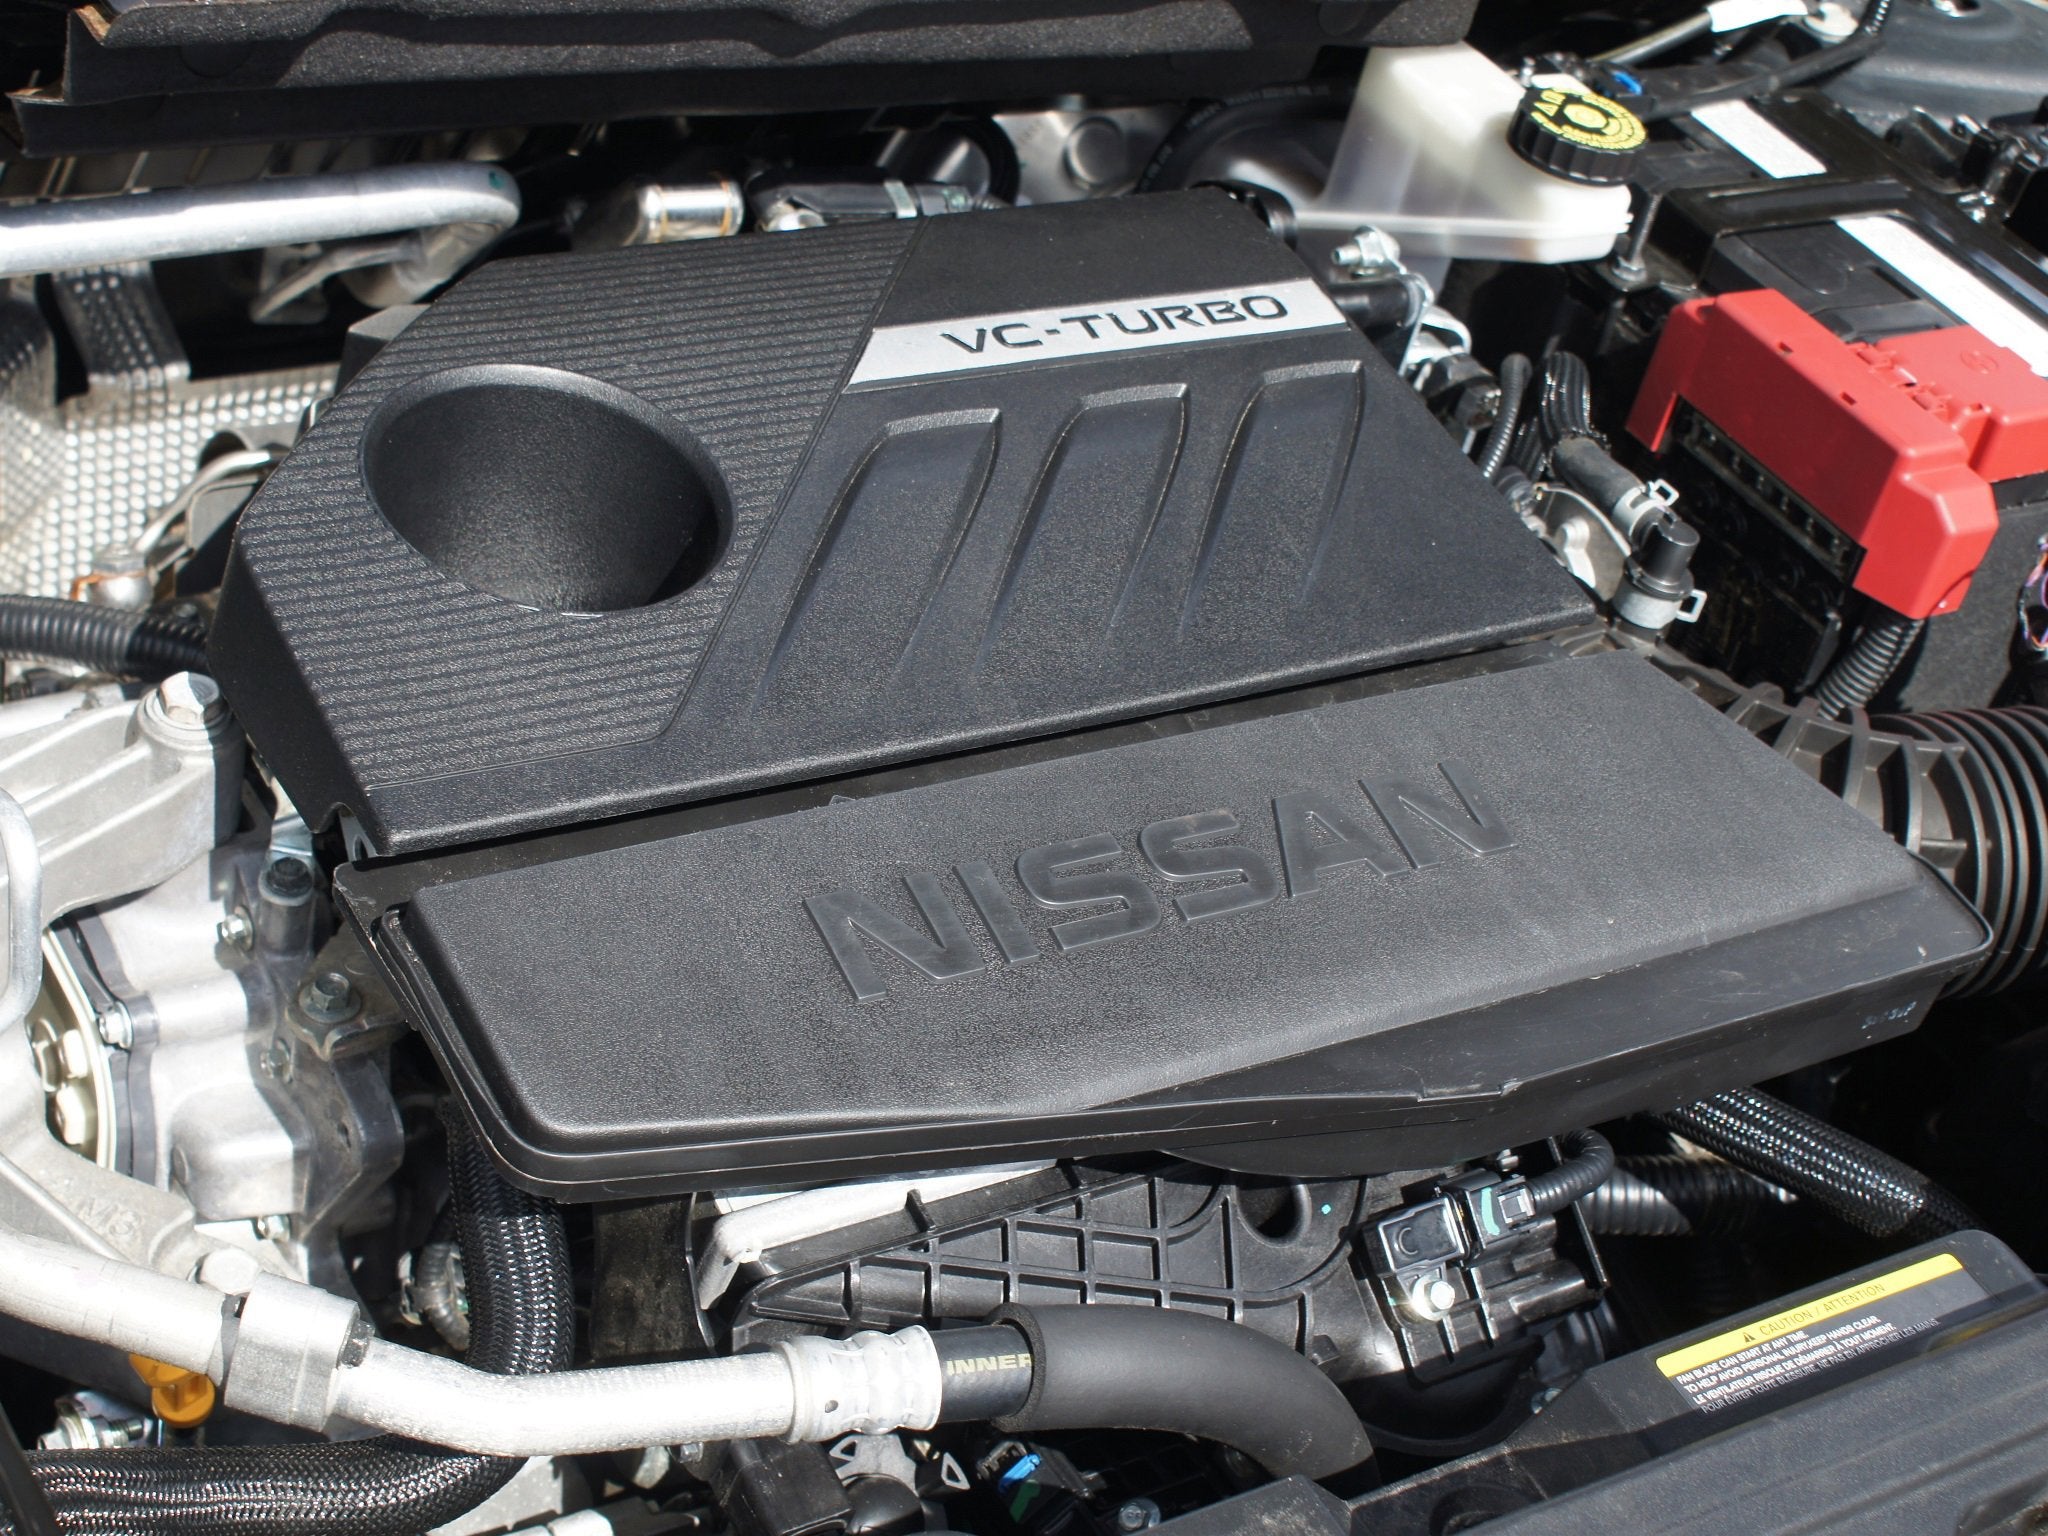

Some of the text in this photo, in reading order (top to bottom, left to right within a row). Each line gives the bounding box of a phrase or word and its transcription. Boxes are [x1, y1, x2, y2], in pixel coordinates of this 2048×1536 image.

[940, 295, 1289, 354] VC-TURBO
[803, 763, 1516, 1001] NISSAN
[1759, 1310, 1814, 1336] CAUTION
[1824, 1283, 1886, 1313] ATTENTION
[1676, 1329, 1809, 1385] FAN BLADE CAN START AT ANY TIME.
[1684, 1383, 1698, 1394] TO
[1696, 1373, 1721, 1389] HELP
[1718, 1366, 1743, 1381] AVOID
[1741, 1352, 1785, 1373] PERSONAL
[1825, 1323, 1856, 1340] HANDS
[1853, 1315, 1882, 1330] CLEAR.
[1692, 1394, 1706, 1405] LE
[1703, 1374, 1758, 1400] VENTILATEUR
[1754, 1364, 1786, 1381] RISQUE
[1783, 1359, 1796, 1371] DE
[1794, 1342, 1839, 1367] DÉMARRER
[1841, 1335, 1864, 1348] TOUT
[1861, 1322, 1897, 1342] MOMENT.
[1701, 1398, 1727, 1414] POUR
[1753, 1378, 1779, 1395] TOUTE
[1818, 1357, 1831, 1370] NE
[1829, 1351, 1847, 1365] PAS
[1855, 1331, 1902, 1355] APPROCHER
[1898, 1325, 1916, 1340] LES
